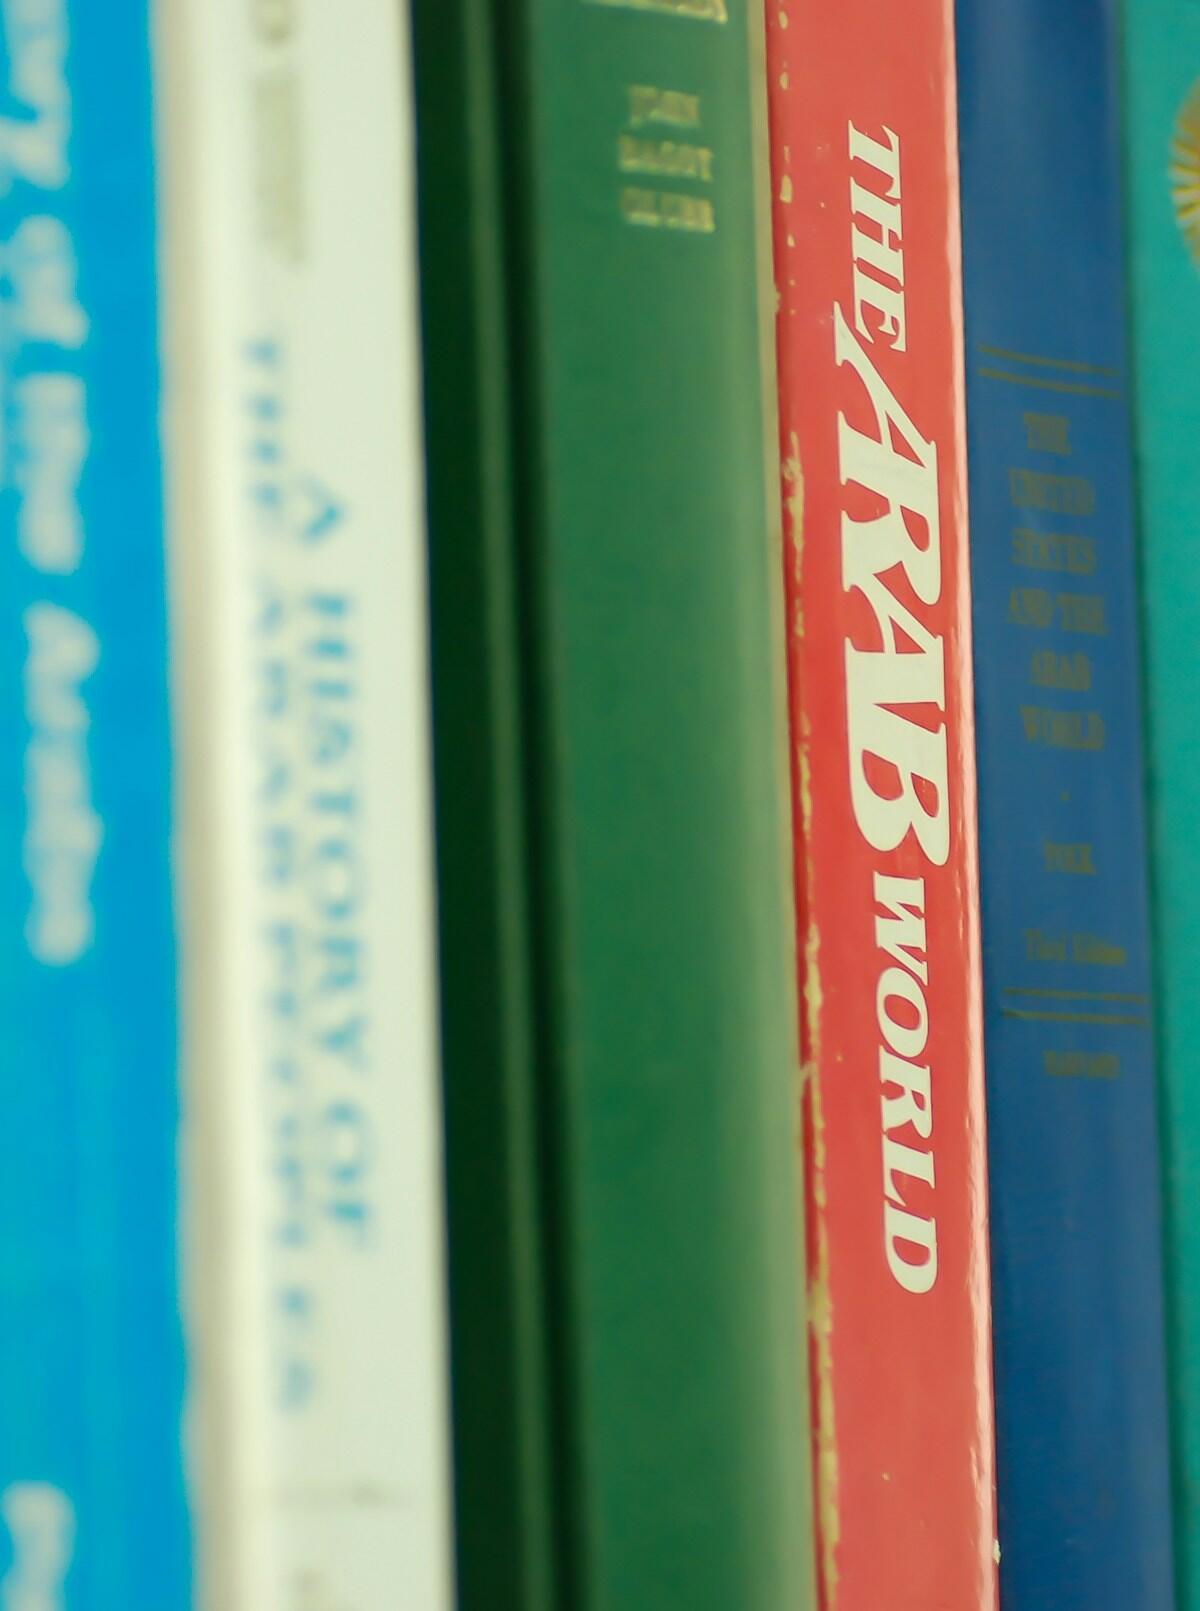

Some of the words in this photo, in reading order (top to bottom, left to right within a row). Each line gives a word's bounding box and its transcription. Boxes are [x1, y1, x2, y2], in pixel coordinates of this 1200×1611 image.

[8, 213, 90, 348] of
[848, 119, 907, 353] THE
[834, 301, 950, 867] ARAB
[308, 594, 368, 1066] HISTORY
[1018, 704, 1106, 751] WORLD
[324, 1100, 372, 1250] OF
[873, 871, 939, 1293] WORLD
